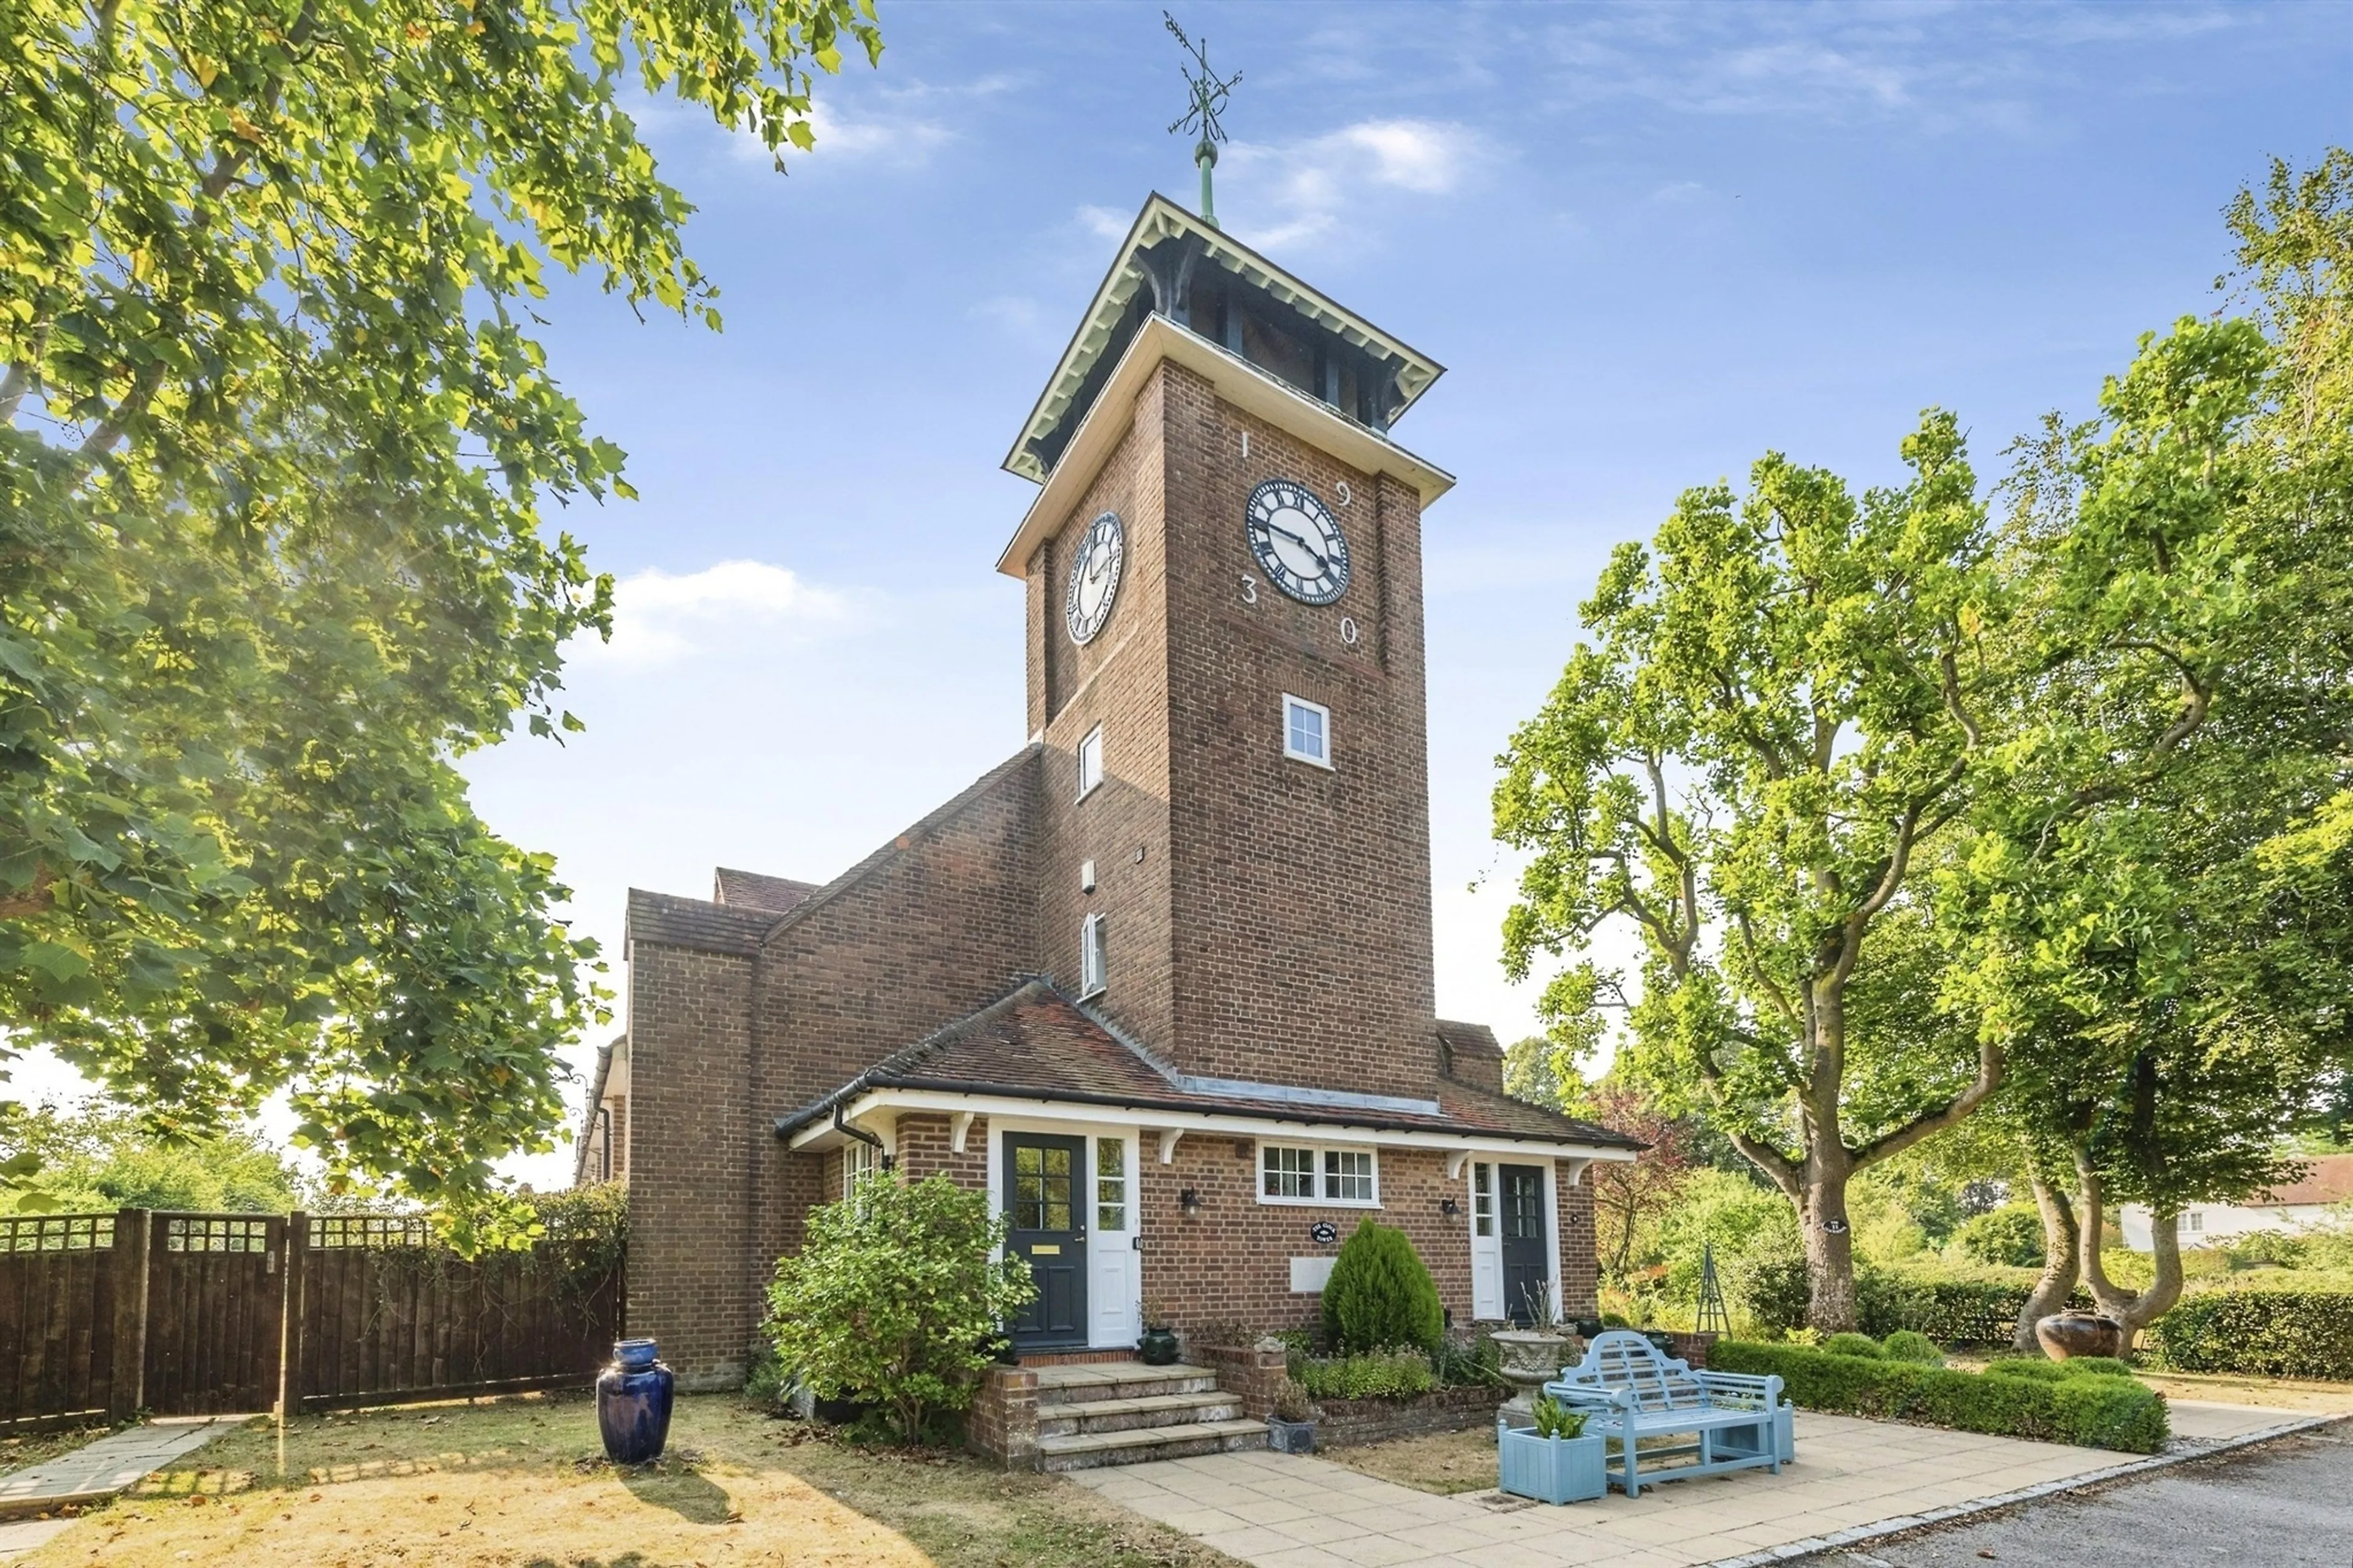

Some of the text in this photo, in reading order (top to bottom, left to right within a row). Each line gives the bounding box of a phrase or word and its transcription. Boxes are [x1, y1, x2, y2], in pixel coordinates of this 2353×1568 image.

[1242, 431, 1248, 458] 1
[1335, 481, 1351, 507] 9
[1241, 574, 1257, 604] 3
[1340, 618, 1357, 644] 0
